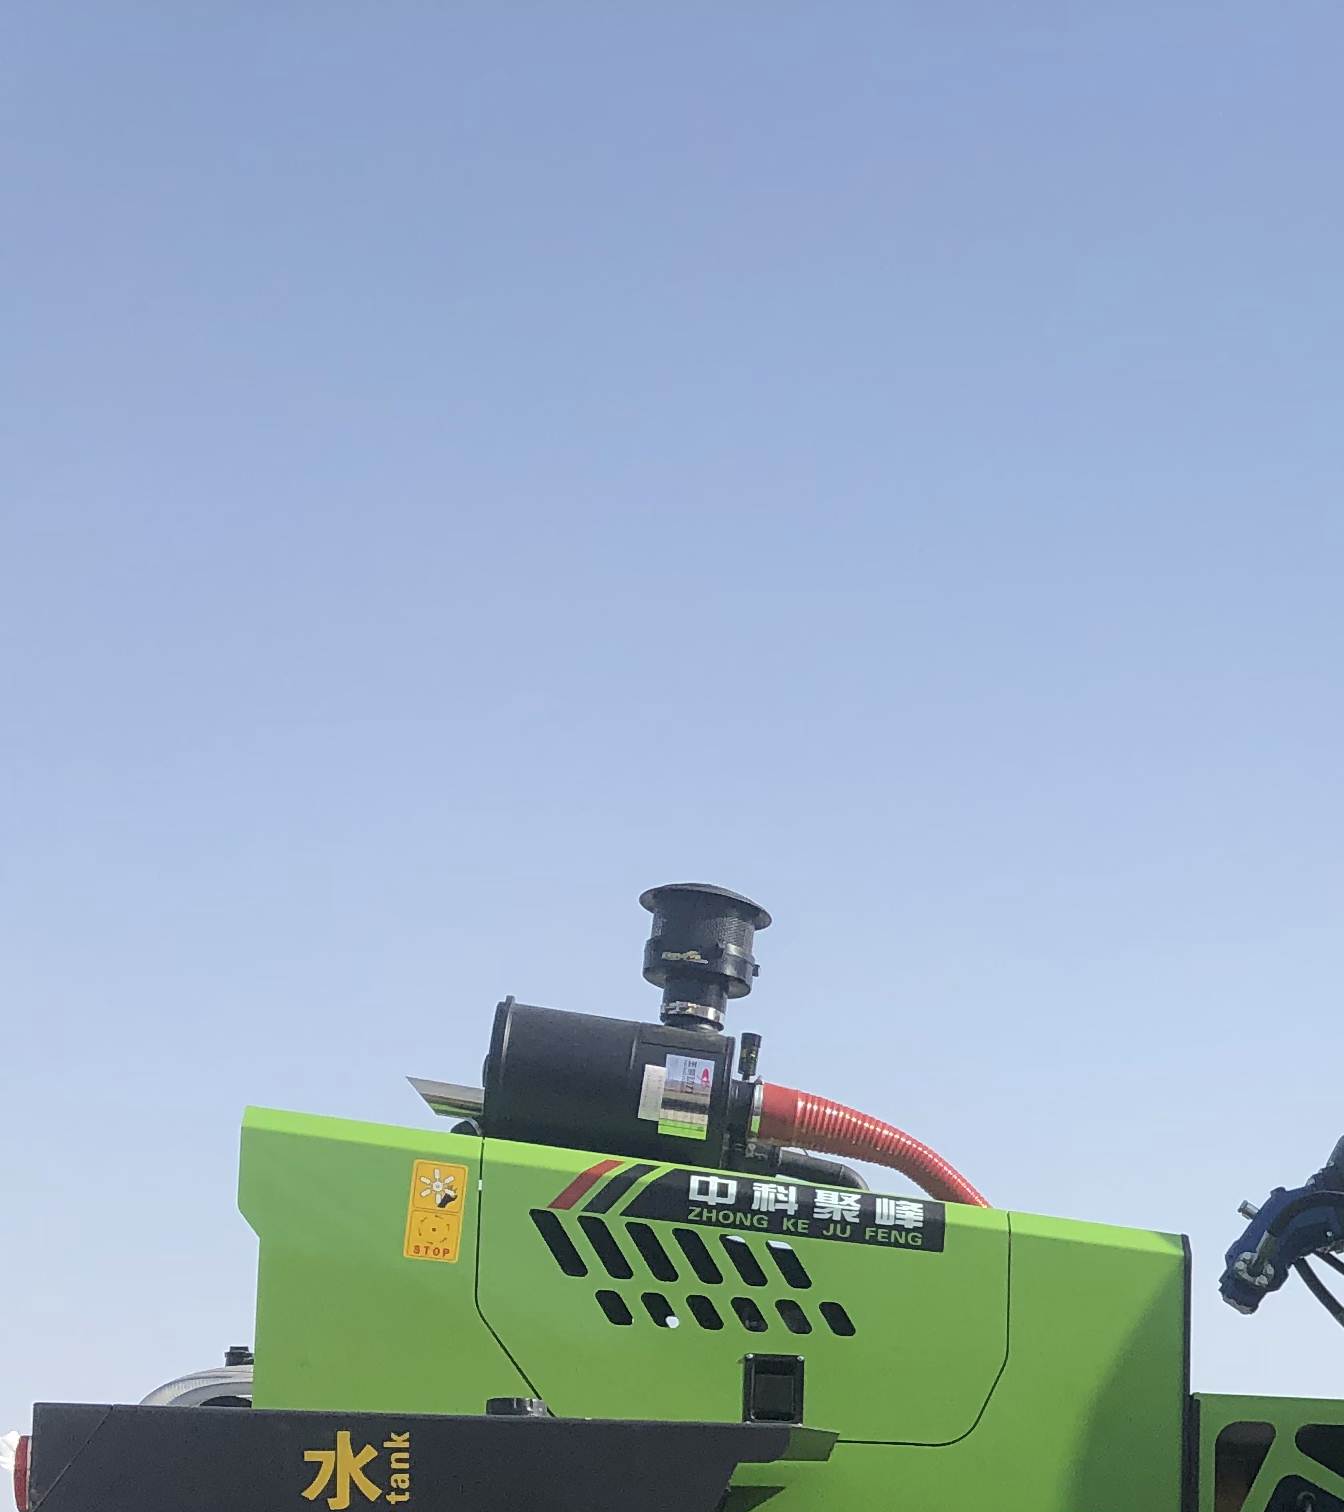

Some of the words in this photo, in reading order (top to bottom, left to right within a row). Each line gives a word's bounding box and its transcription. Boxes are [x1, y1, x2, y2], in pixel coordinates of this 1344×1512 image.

[688, 1175, 924, 1229] 中科聚峰
[688, 1206, 769, 1228] ZHONG
[782, 1217, 809, 1234] KE
[823, 1222, 851, 1239] JU
[865, 1227, 923, 1246] FENG
[413, 1244, 450, 1258] STOP
[383, 1431, 410, 1505] tank
